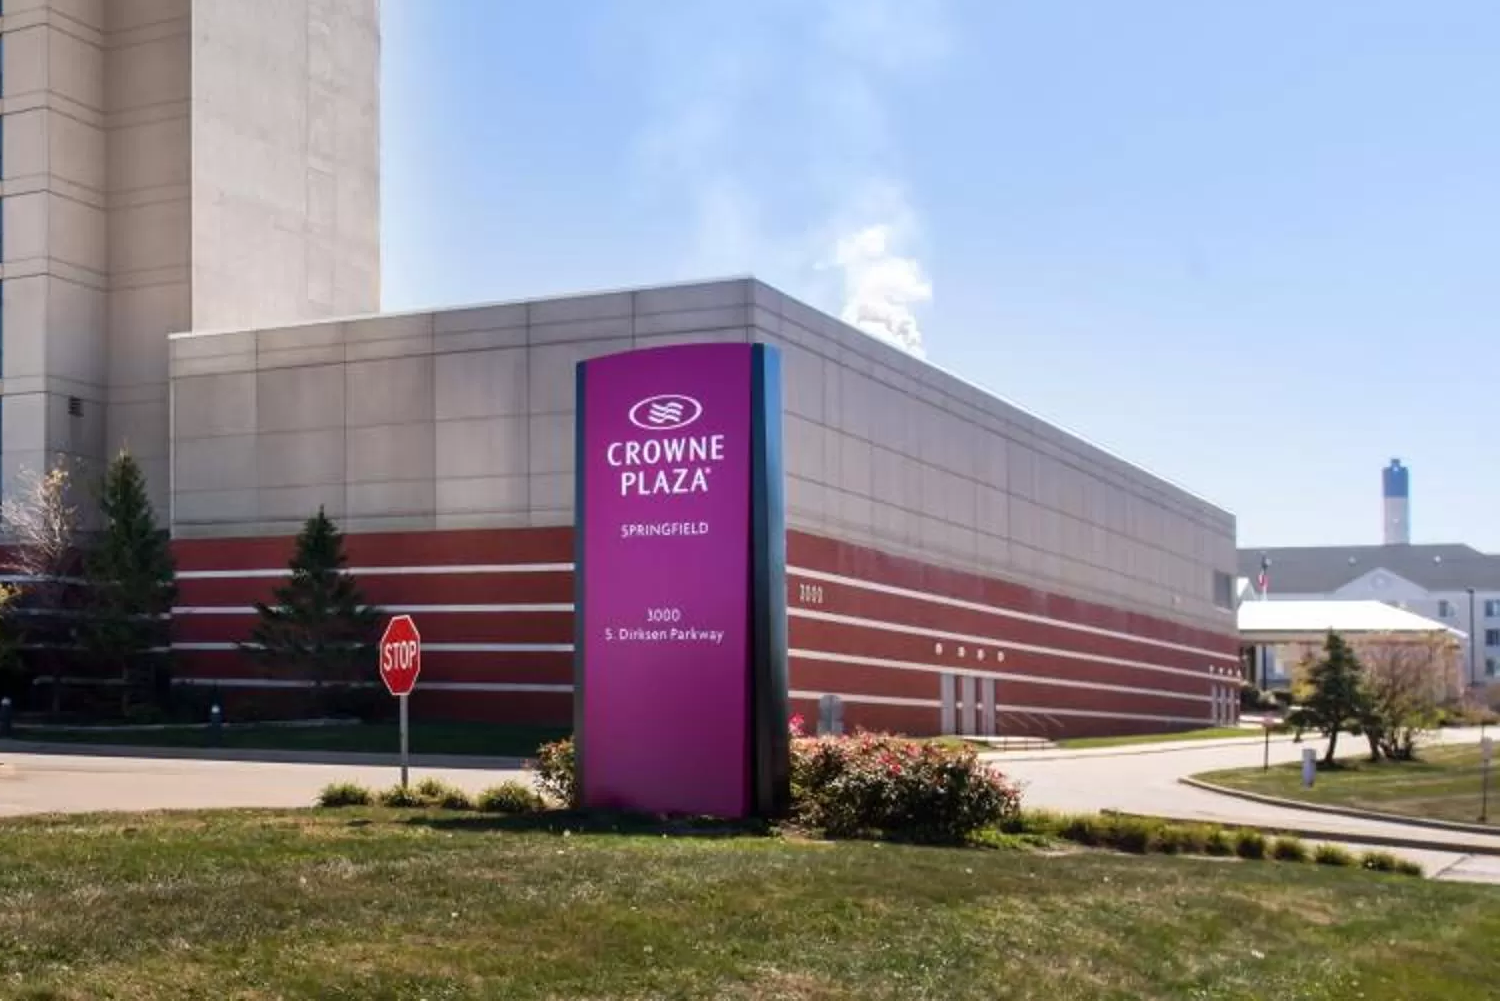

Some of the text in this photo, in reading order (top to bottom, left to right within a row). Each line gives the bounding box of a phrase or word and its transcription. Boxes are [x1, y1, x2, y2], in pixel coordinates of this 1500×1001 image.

[607, 434, 725, 466] CROWNE
[621, 467, 708, 496] PLAZA
[621, 522, 709, 538] SPRINGFIELD
[647, 607, 681, 622] 3000
[619, 628, 667, 640] Dirksen
[670, 627, 725, 644] Parkway
[384, 640, 417, 671] STOP
